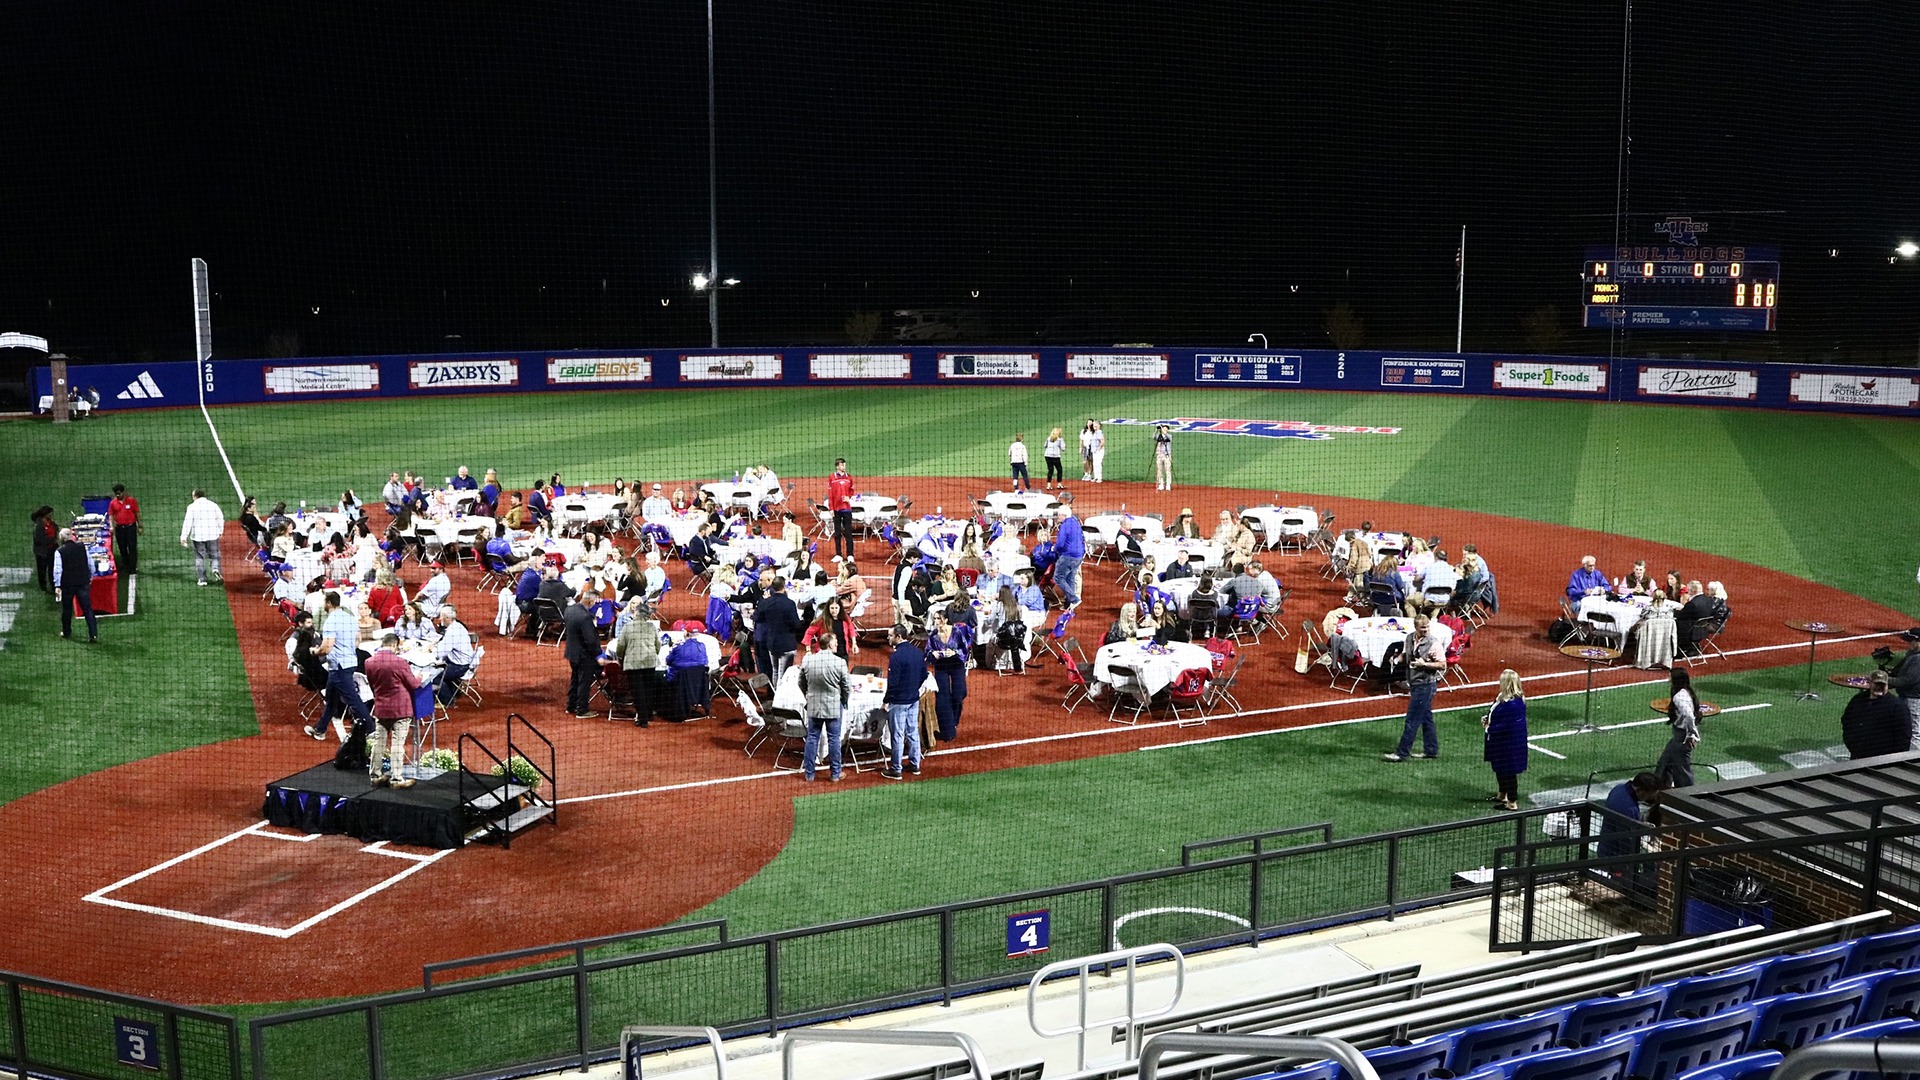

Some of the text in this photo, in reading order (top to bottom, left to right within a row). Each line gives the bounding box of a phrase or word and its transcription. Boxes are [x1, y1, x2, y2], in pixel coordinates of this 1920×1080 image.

[1618, 247, 1745, 260] BULLDOGS
[1619, 263, 1740, 277] BALL 0 STRIKE 0 OUT 0
[1594, 284, 1775, 295] MONICA 0 0 0
[1592, 294, 1774, 306] ABBOTT 0 0 0
[560, 362, 639, 376] rapidSIGNS
[976, 361, 1012, 369] Orthopaedic
[204, 364, 214, 392] 200
[427, 364, 501, 384] ZAXBY'S
[976, 368, 996, 376] Sports
[1509, 368, 1590, 385] Super 1 Foods
[1659, 371, 1737, 392] Patton's
[1830, 389, 1879, 397] APOTHECARE
[1015, 916, 1043, 926] SECTION
[1020, 925, 1038, 947] 4
[122, 1026, 149, 1036] SECTION
[128, 1035, 146, 1061] 3
